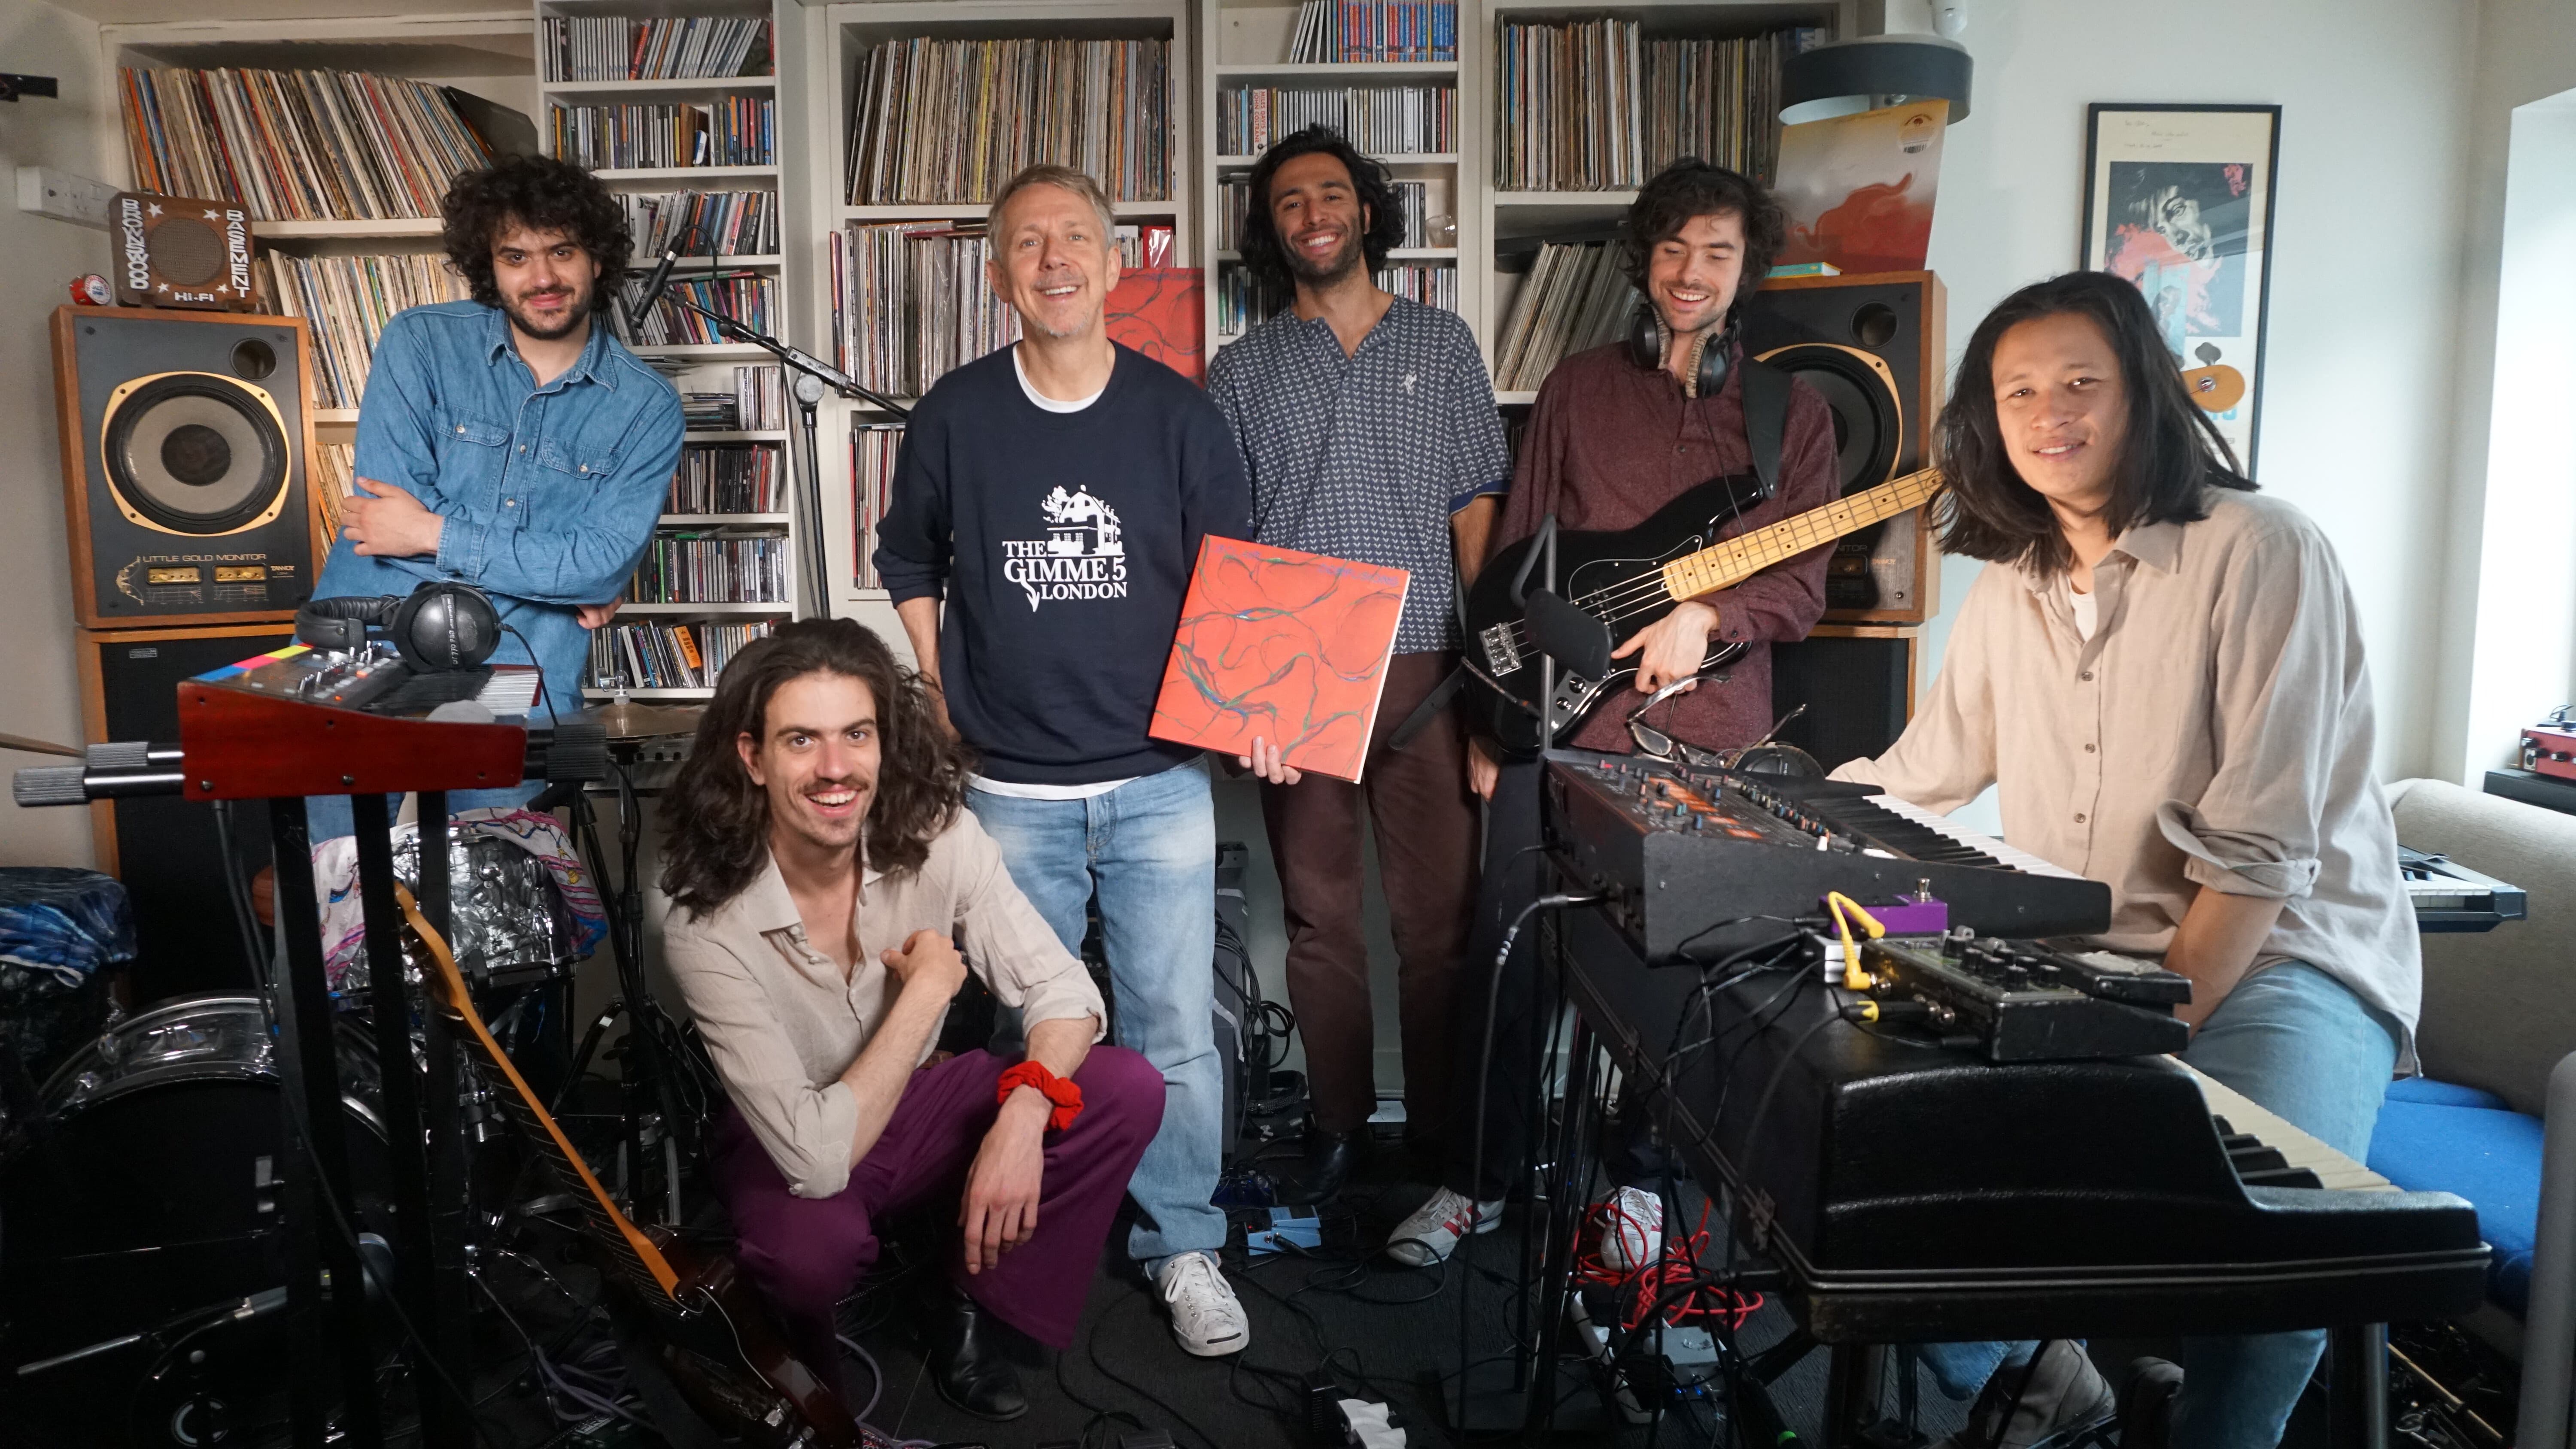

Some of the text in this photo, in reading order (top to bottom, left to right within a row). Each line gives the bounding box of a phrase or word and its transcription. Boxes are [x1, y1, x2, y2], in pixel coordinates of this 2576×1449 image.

[122, 198, 149, 290] BROWNSWOOD
[226, 209, 250, 298] BASEMENT
[1002, 540, 1047, 558] THE
[1004, 556, 1127, 587] GIMME 5
[1040, 582, 1128, 600] LONDON
[450, 644, 459, 655] 770
